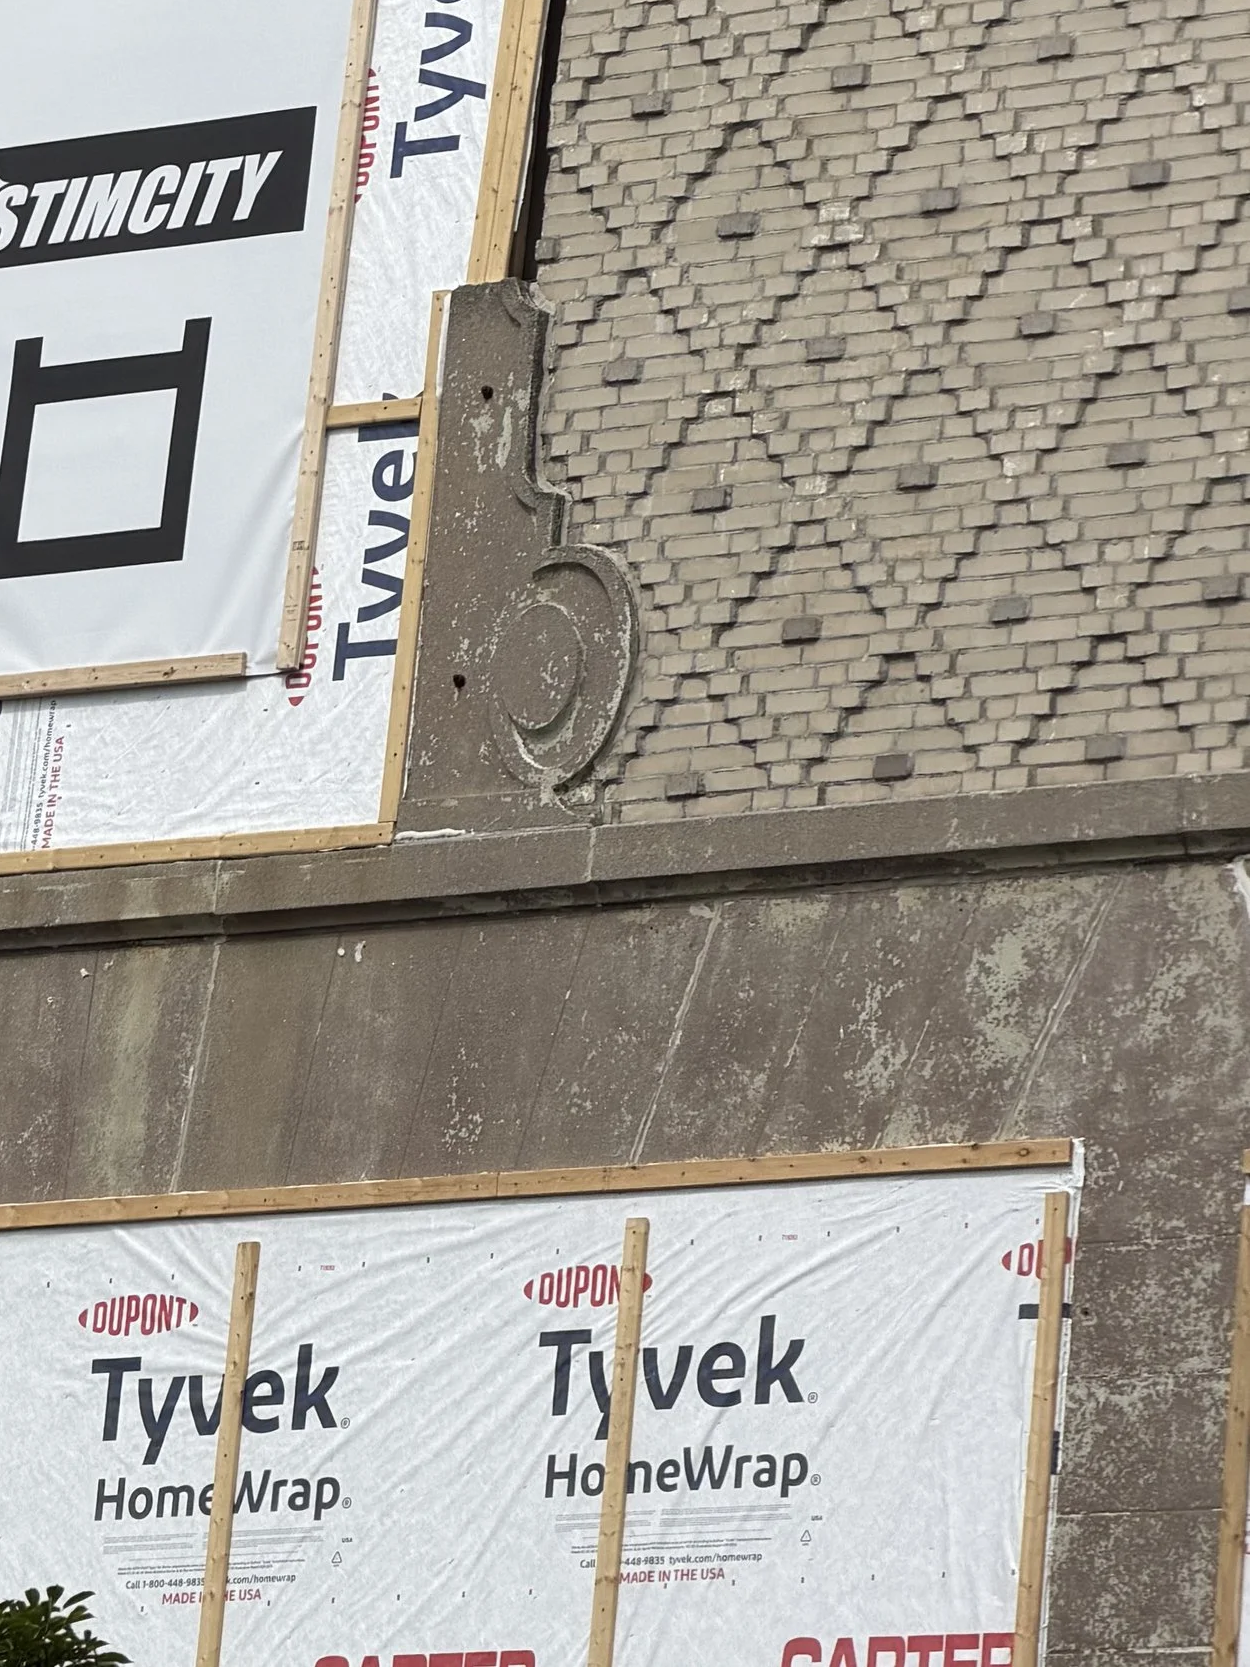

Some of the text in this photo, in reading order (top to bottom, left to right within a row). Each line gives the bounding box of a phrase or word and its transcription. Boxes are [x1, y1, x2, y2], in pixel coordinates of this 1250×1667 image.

[41, 735, 65, 849] MADE IN THE USA
[538, 1263, 621, 1308] DUPON
[92, 1293, 187, 1336] DUPONT
[579, 1559, 596, 1569] Call
[668, 1551, 763, 1565] tyvek.com/homewrap
[619, 1567, 726, 1584] MADE IN THE USA
[125, 1580, 141, 1590] Call
[162, 1592, 197, 1605] MADE
[238, 1588, 262, 1601] USA
